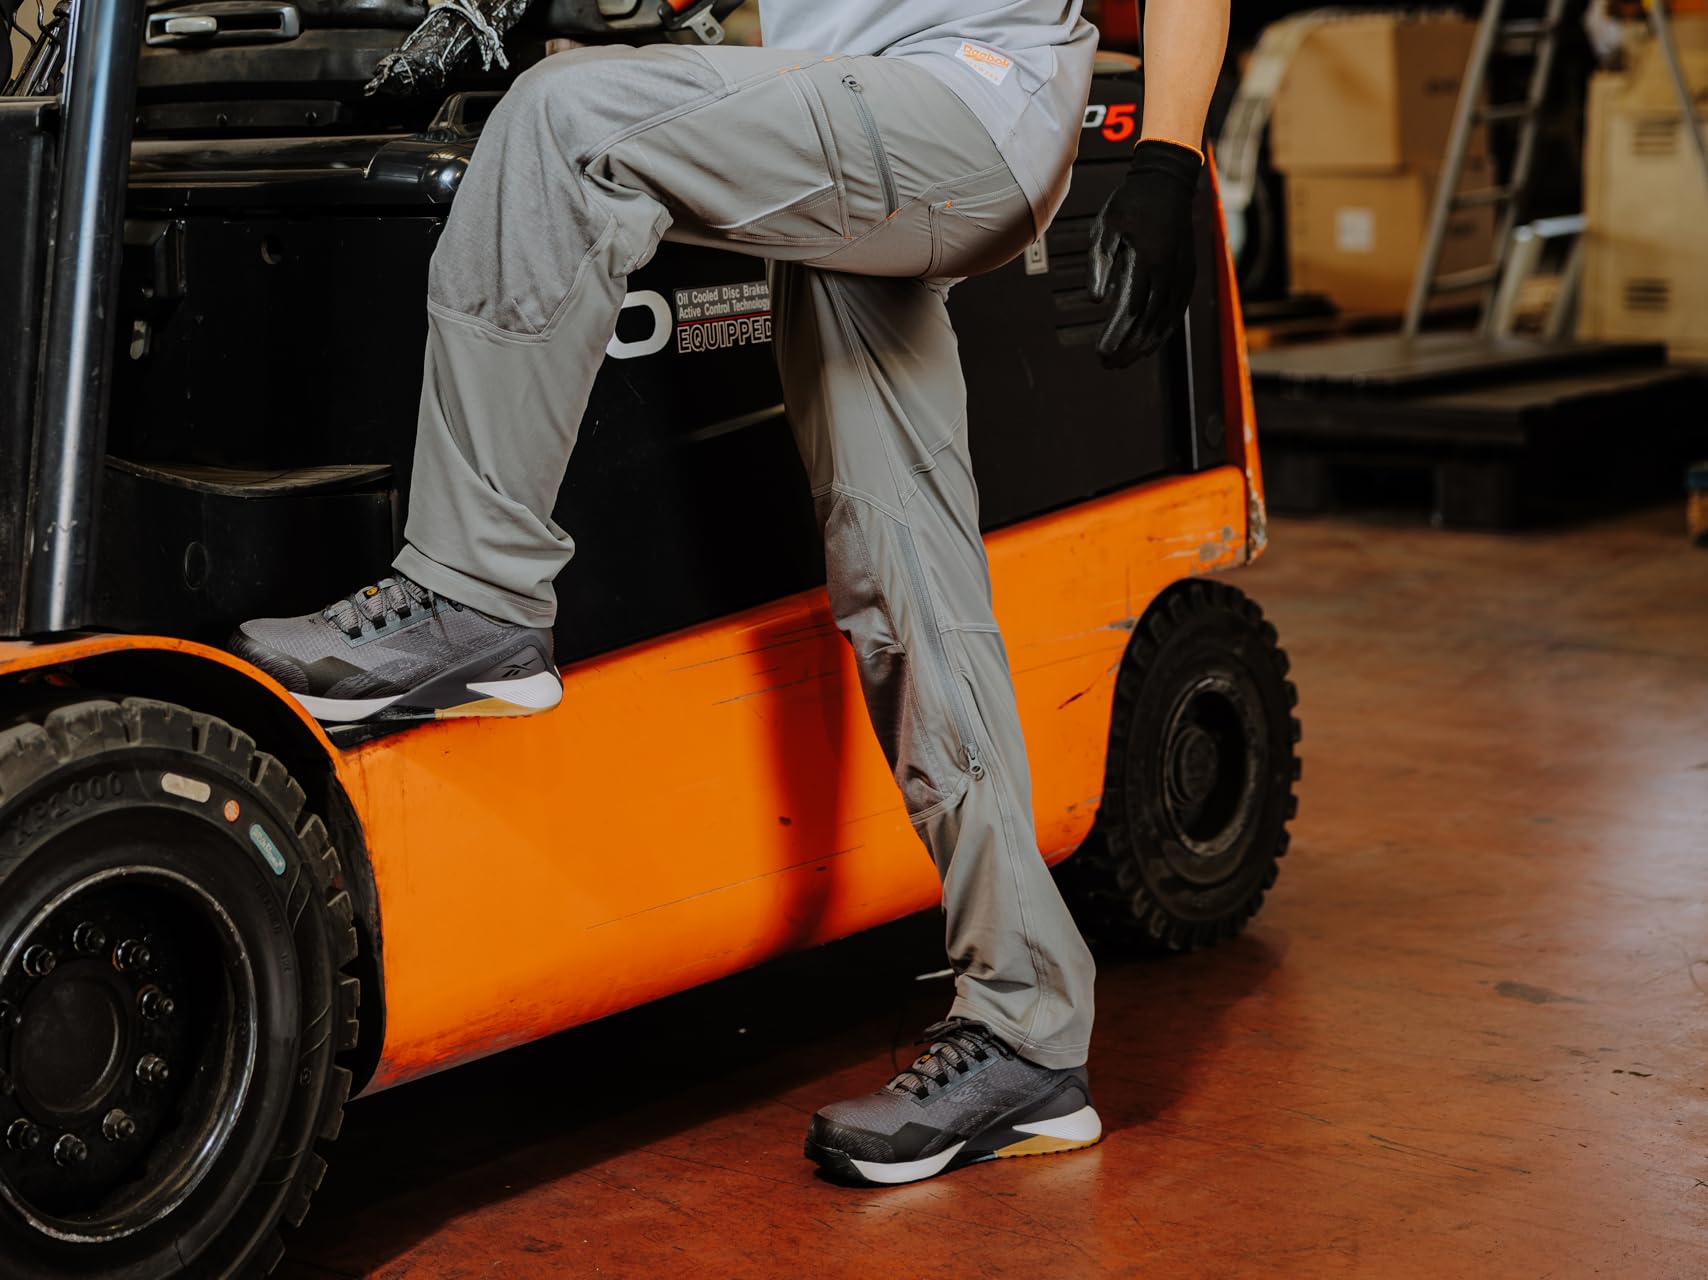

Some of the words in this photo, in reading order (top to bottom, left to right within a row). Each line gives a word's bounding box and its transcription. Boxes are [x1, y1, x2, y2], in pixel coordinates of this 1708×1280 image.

[677, 292, 689, 305] Oil
[691, 288, 719, 303] Cooled
[722, 287, 740, 300] Disc
[743, 283, 769, 297] Brakes
[679, 305, 702, 319] Active
[703, 301, 730, 316] Control
